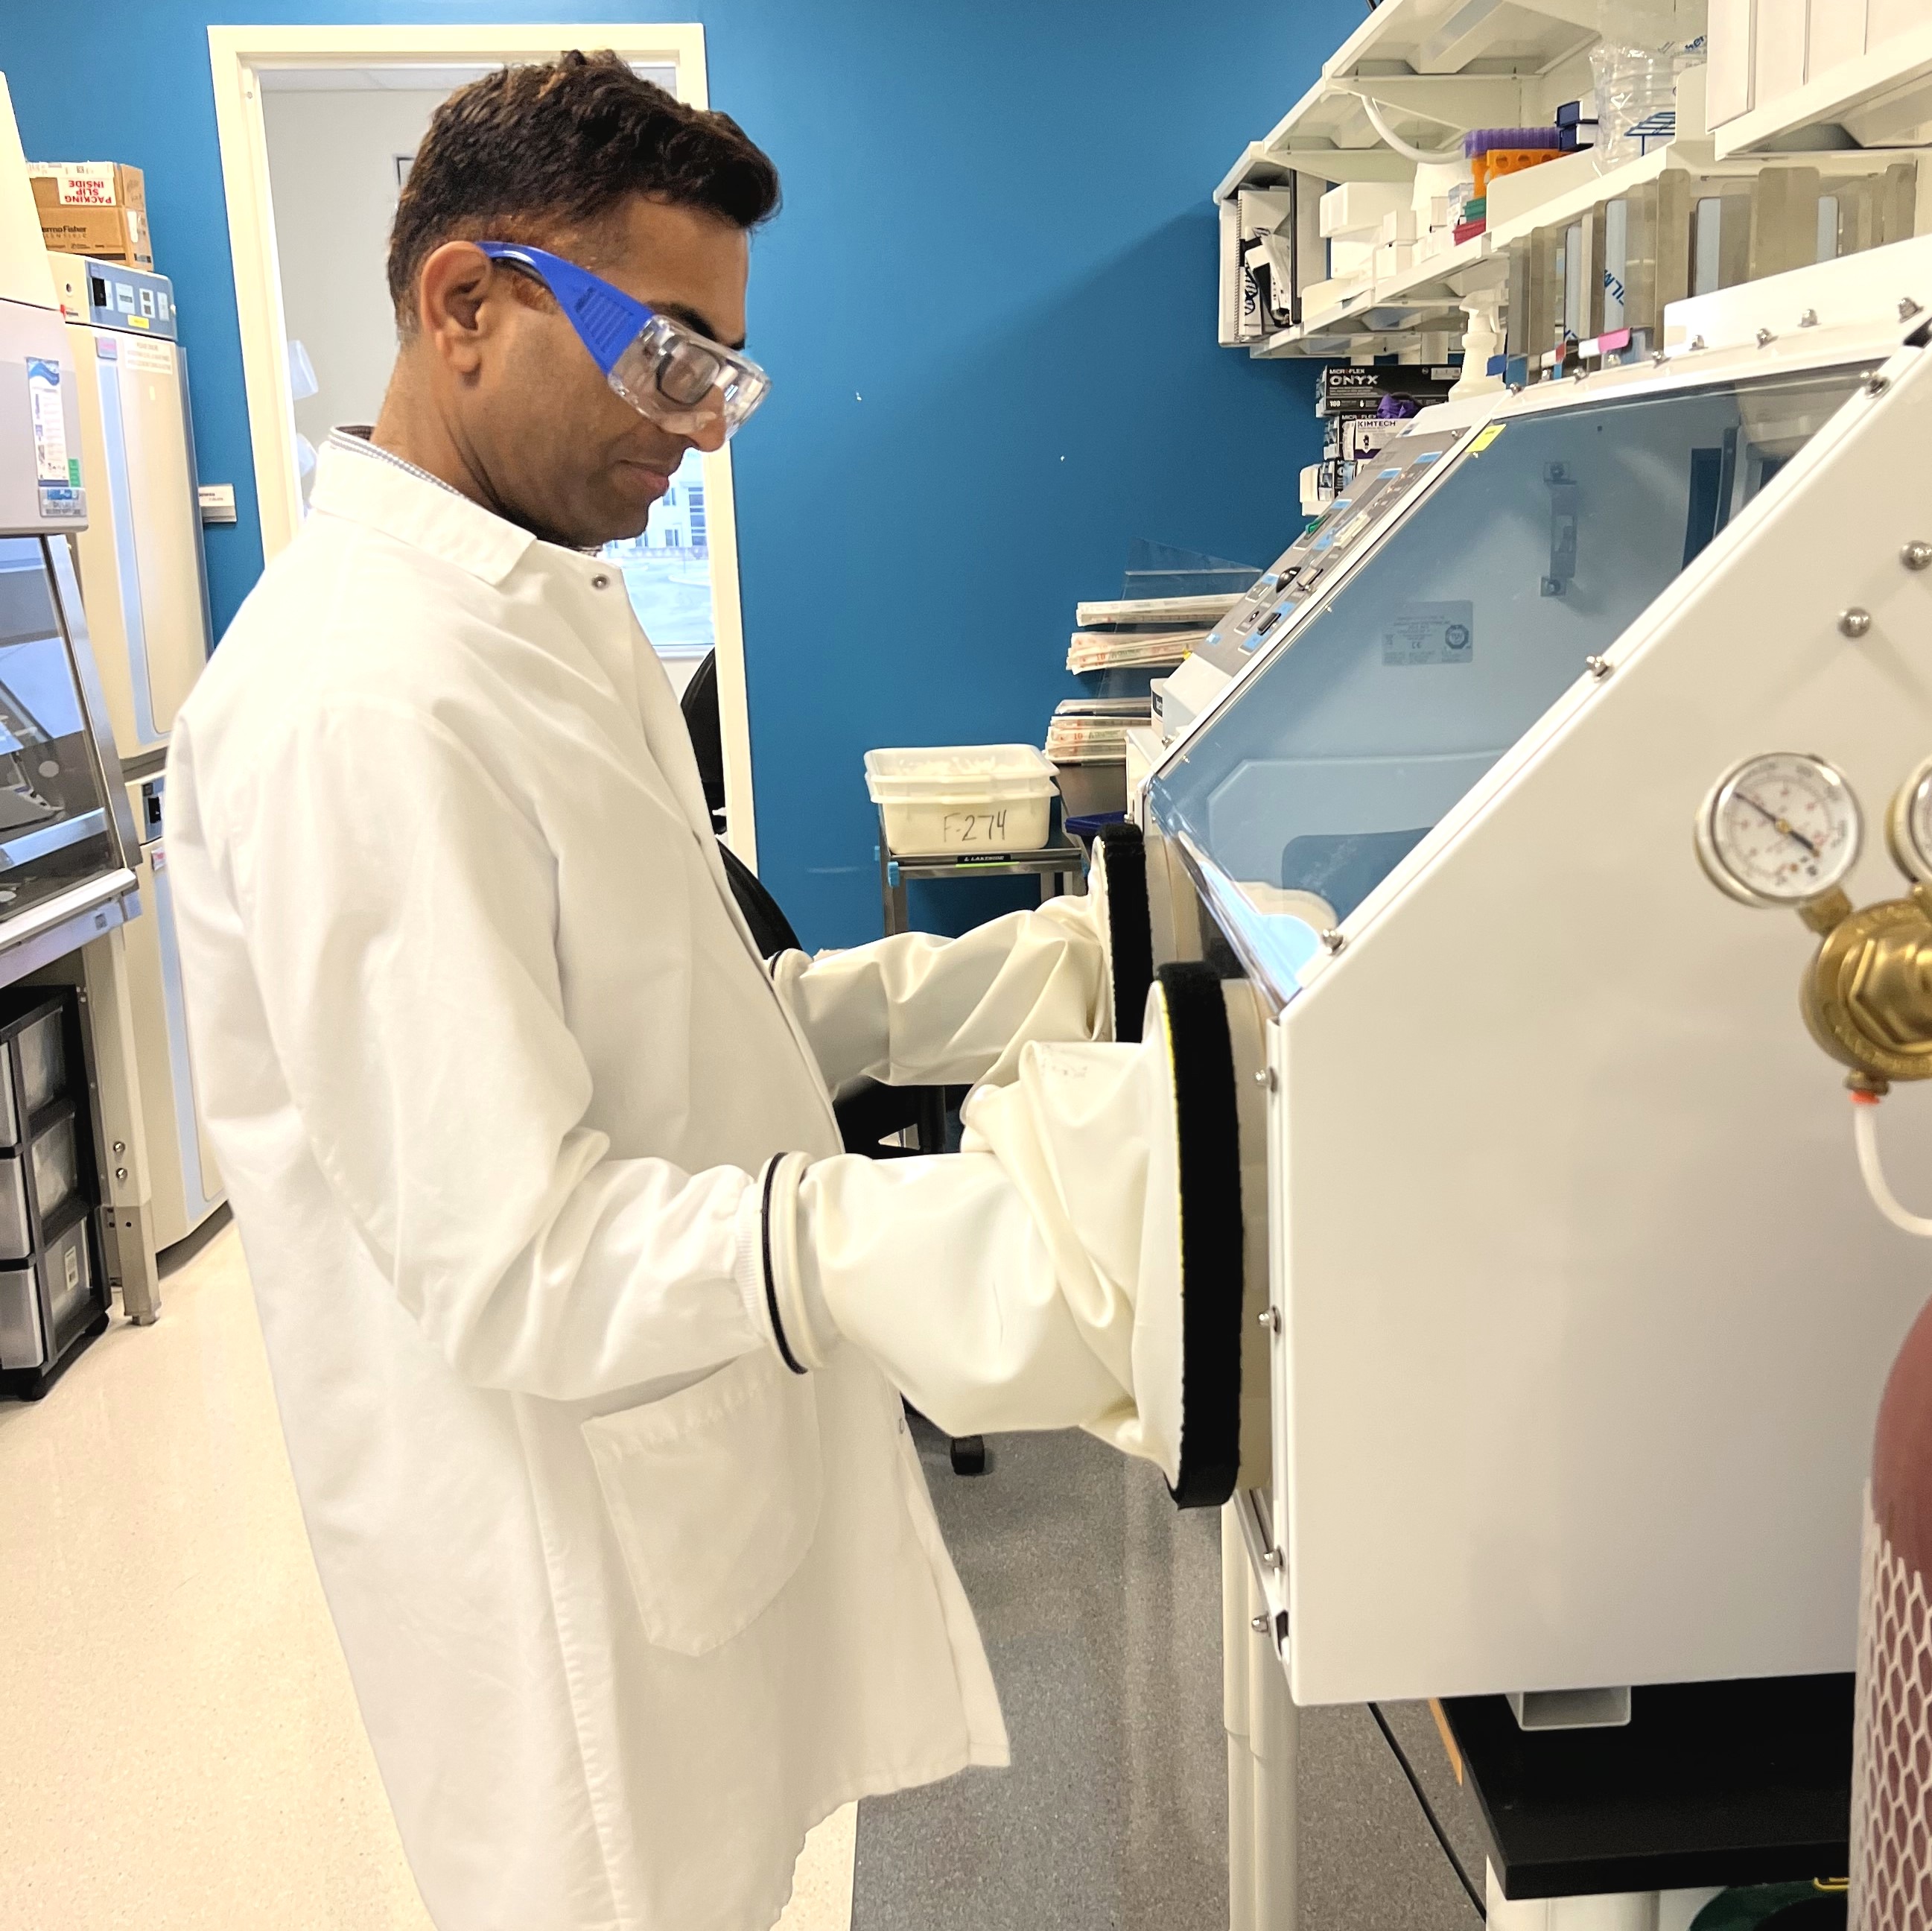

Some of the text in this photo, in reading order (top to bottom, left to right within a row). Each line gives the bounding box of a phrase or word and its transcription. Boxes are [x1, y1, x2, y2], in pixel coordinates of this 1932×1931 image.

[69, 180, 104, 188] INSIDE
[65, 195, 112, 203] PACKING
[1329, 375, 1380, 385] ONYX
[944, 809, 1007, 843] F-274
